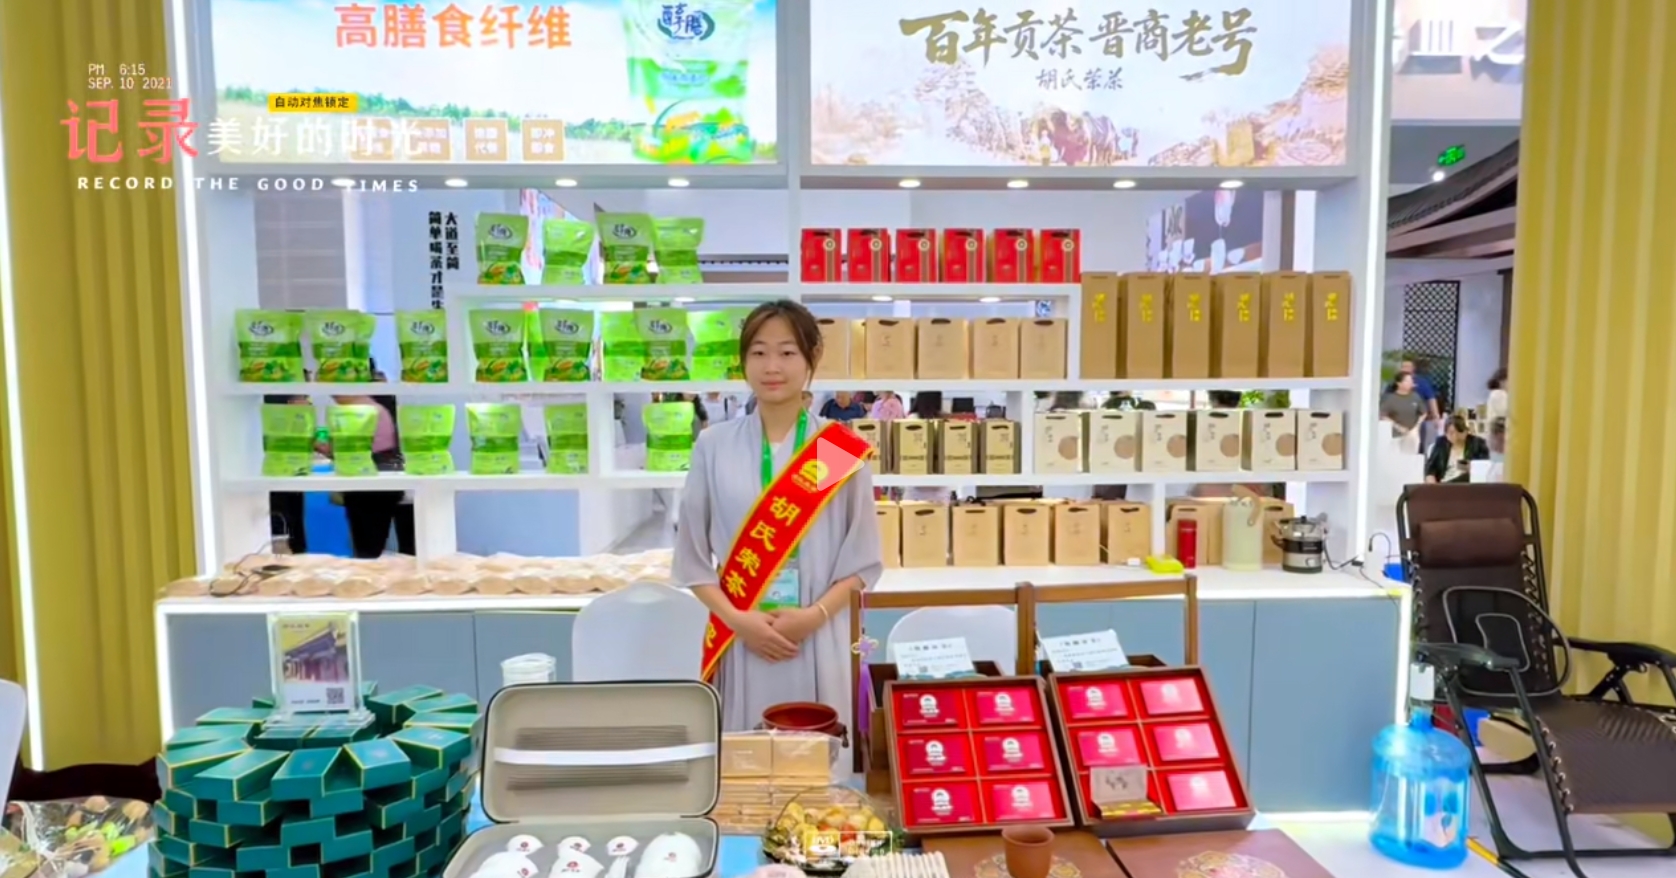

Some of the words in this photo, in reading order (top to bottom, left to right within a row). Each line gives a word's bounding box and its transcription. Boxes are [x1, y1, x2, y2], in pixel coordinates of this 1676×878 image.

[334, 3, 572, 49] 高膳食纤维
[899, 8, 1084, 68] 百年贡茶
[1088, 7, 1257, 82] 晋商老号
[444, 211, 460, 270] 大道至简
